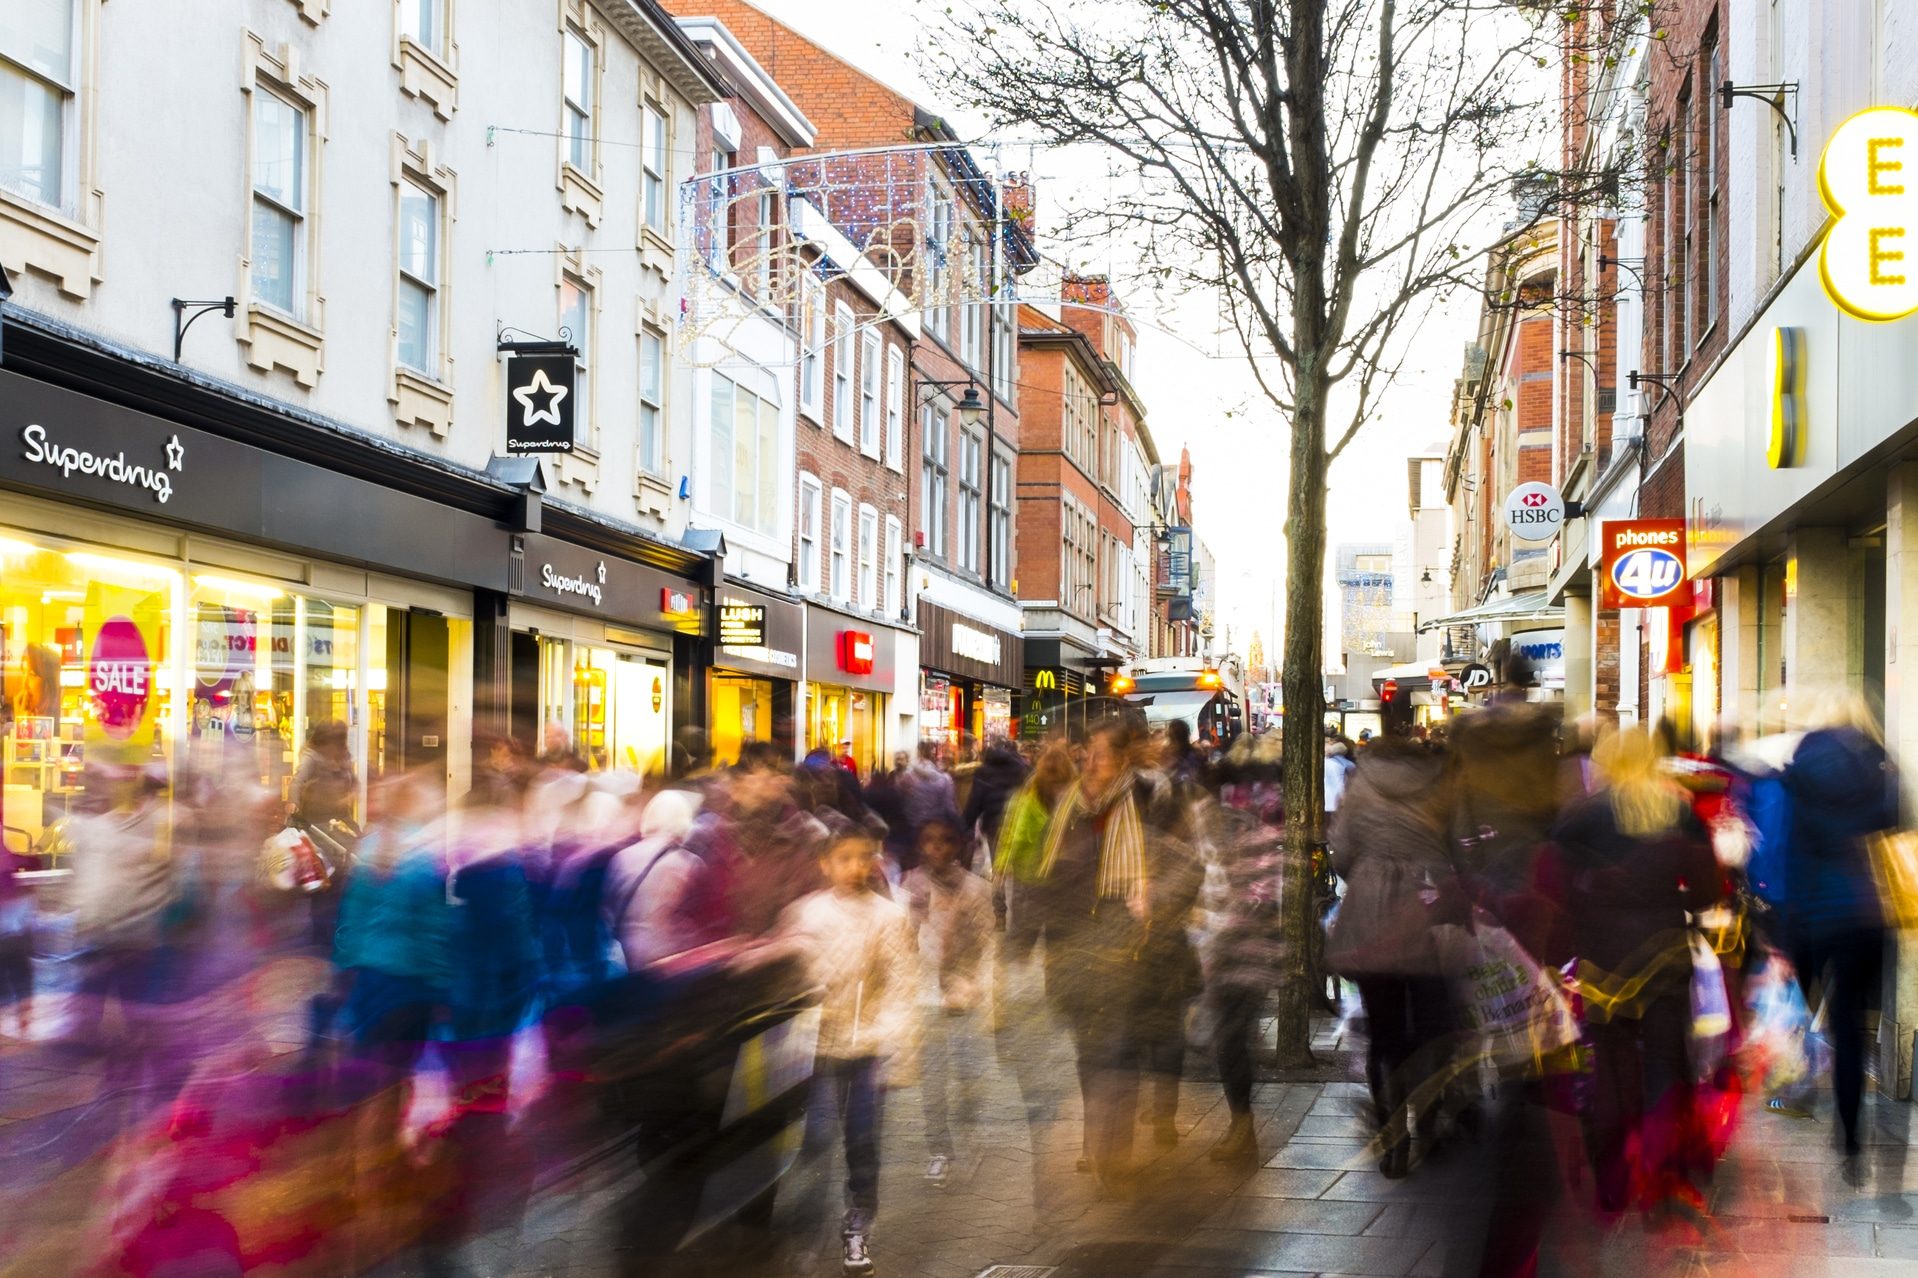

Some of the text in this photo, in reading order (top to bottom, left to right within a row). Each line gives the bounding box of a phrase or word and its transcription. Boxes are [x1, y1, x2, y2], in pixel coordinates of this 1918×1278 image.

[508, 438, 571, 450] Superdrug
[24, 424, 173, 504] Superdrug
[1511, 509, 1560, 524] HSBC
[1616, 529, 1679, 549] phones
[542, 563, 602, 606] Superdrug
[720, 607, 763, 621] LUSH
[1362, 639, 1395, 657] John Lewis
[1520, 642, 1562, 661] SPORTS
[95, 661, 145, 695] SALE
[1465, 669, 1490, 686] JD
[1025, 714, 1040, 726] 140
